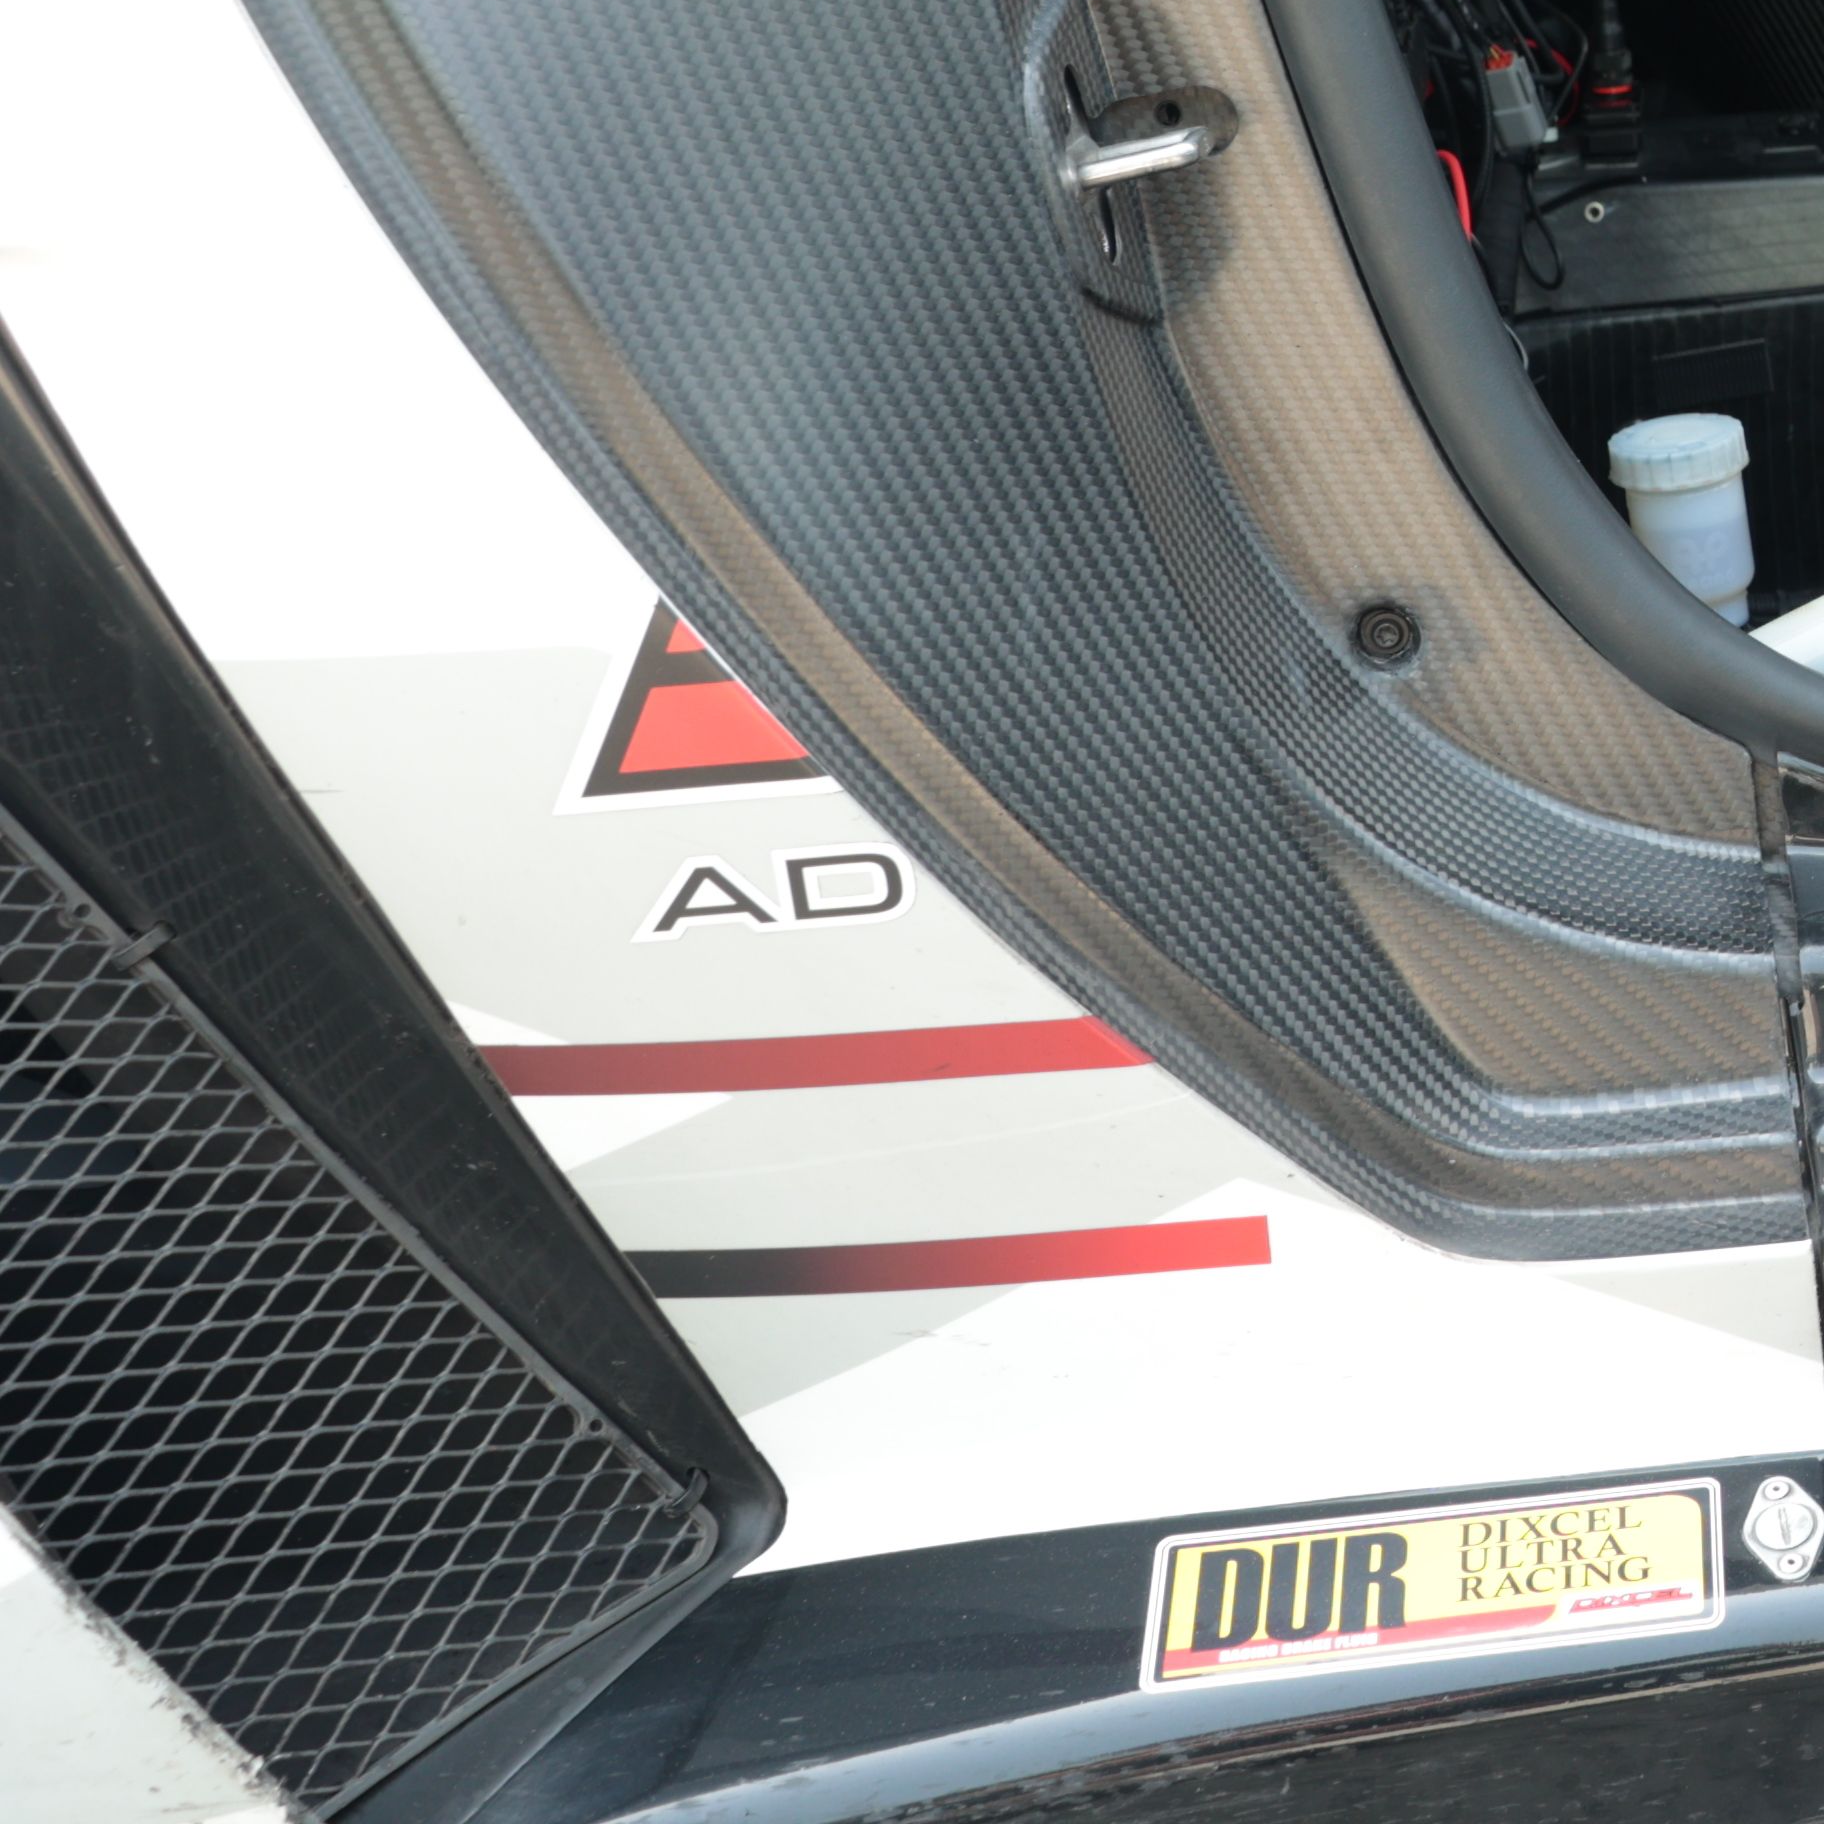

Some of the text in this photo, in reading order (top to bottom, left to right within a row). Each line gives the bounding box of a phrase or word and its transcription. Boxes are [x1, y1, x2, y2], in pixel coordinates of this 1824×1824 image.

[1459, 1506, 1642, 1548] DIXCEL
[1459, 1533, 1627, 1574] ULTRA
[1191, 1532, 1409, 1653] DUR
[1456, 1556, 1652, 1602] RACING
